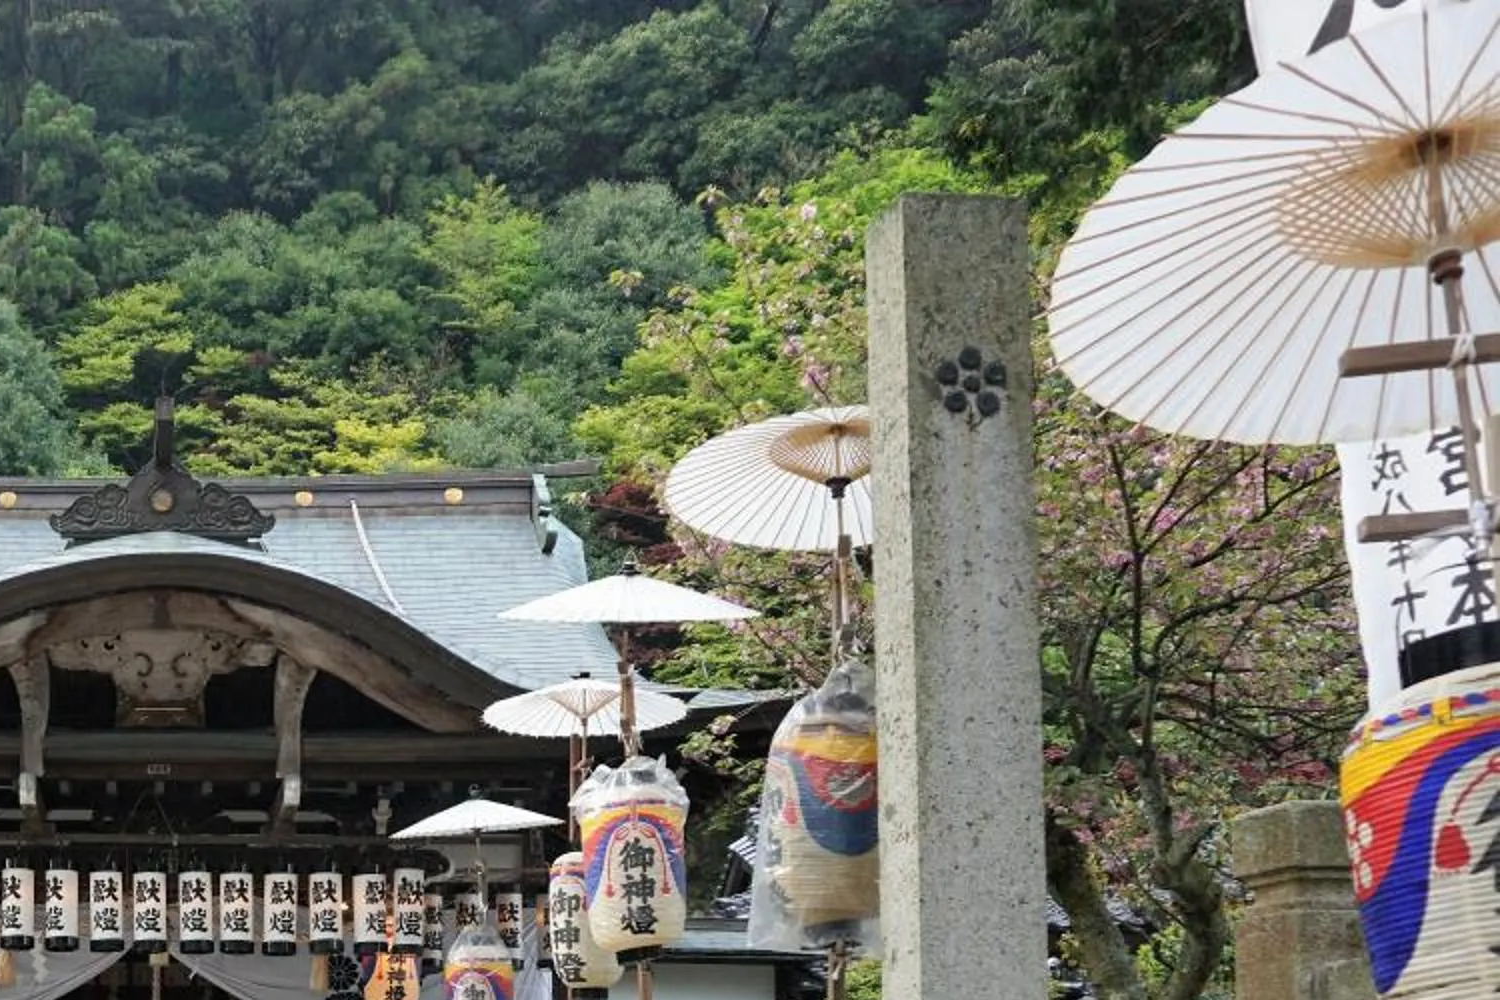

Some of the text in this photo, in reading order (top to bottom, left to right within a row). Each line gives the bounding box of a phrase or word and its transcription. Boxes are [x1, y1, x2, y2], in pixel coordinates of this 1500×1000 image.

[620, 837, 659, 935] 御神燈
[551, 888, 588, 982] 御神燈
